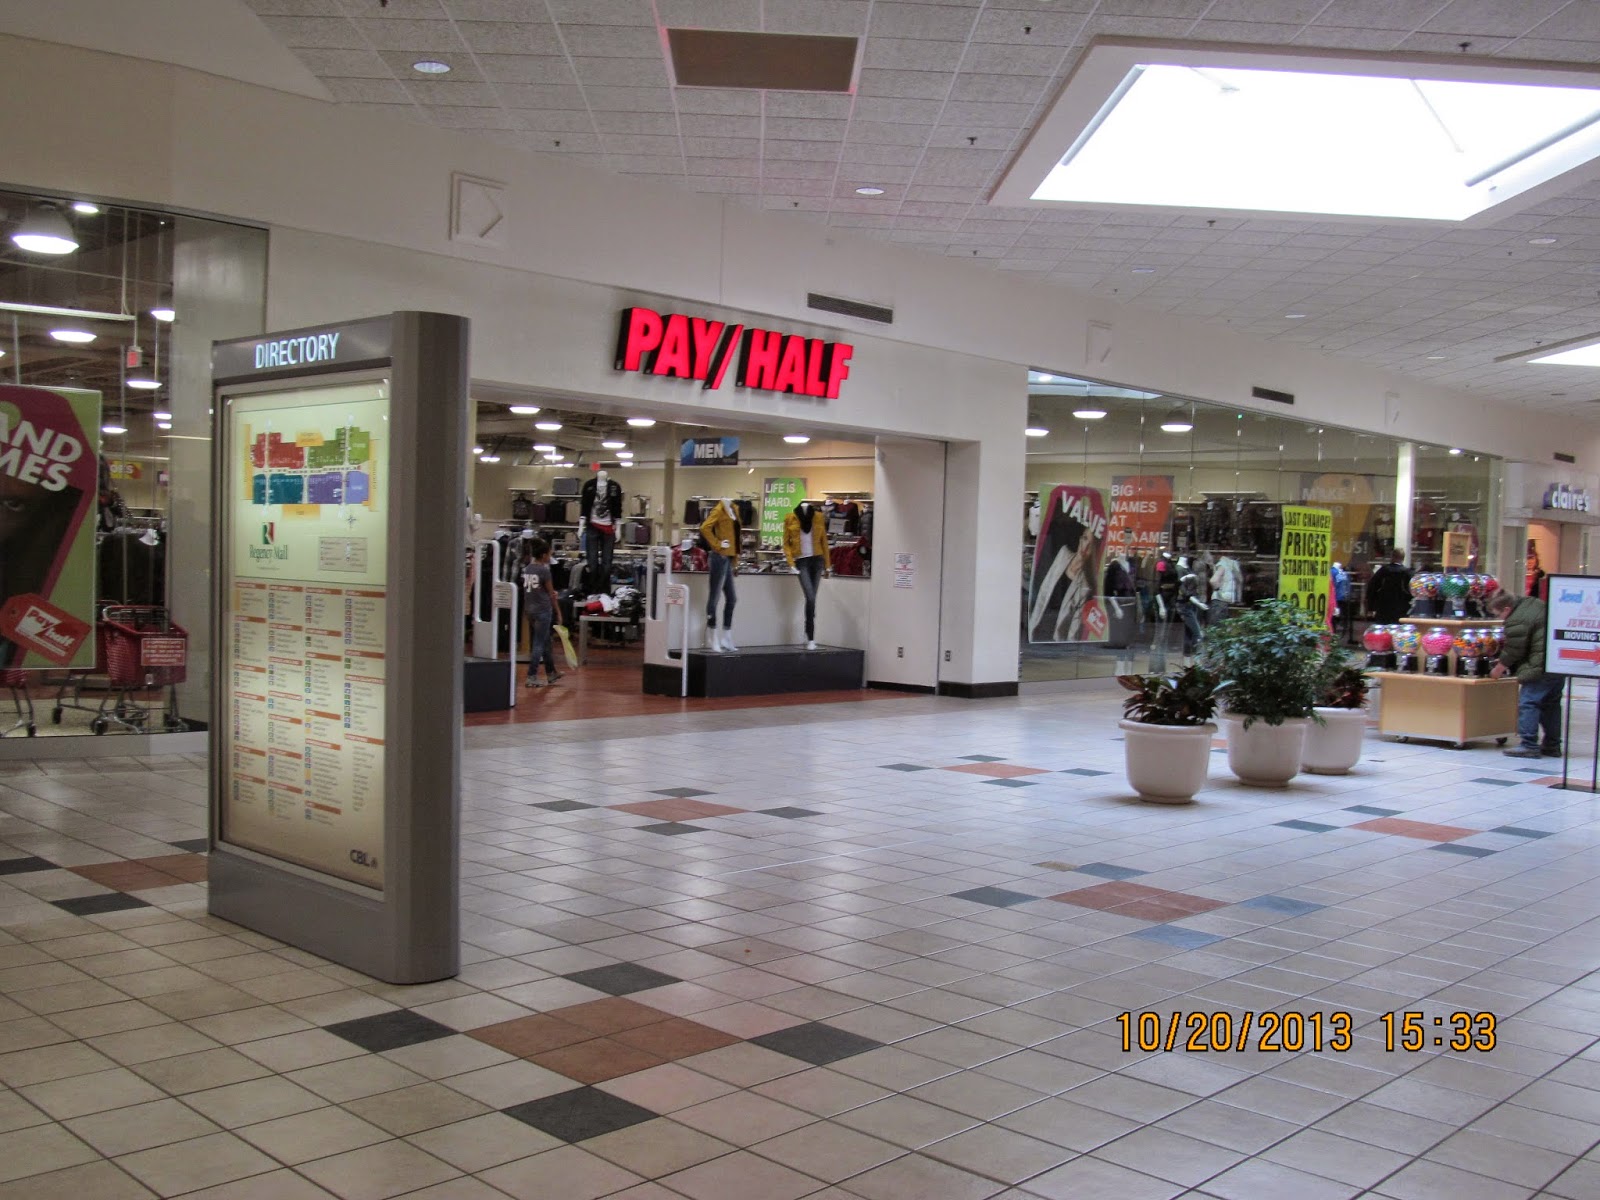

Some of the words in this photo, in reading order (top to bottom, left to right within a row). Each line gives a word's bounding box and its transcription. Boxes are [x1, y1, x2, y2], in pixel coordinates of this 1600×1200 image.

[255, 332, 340, 369] DIRECTORY
[614, 306, 853, 400] PAY/HALF
[693, 443, 724, 459] MEN
[765, 483, 785, 494] LIFE
[786, 483, 796, 493] IS
[1111, 484, 1134, 497] BIG
[764, 497, 792, 508] HARD.
[1551, 483, 1590, 512] claire's
[764, 510, 779, 520] WE
[1062, 490, 1107, 540] VALUE
[1111, 501, 1158, 513] NAMES
[1109, 515, 1128, 527] AT
[1285, 511, 1301, 526] LAST
[1302, 513, 1331, 529] CHANCE!
[274, 544, 288, 560] Mall
[1285, 531, 1327, 558] PRICES
[1282, 559, 1319, 576] STARTING
[1320, 560, 1328, 576] AT
[1298, 578, 1315, 592] ONLY
[1563, 631, 1596, 642] MOVING
